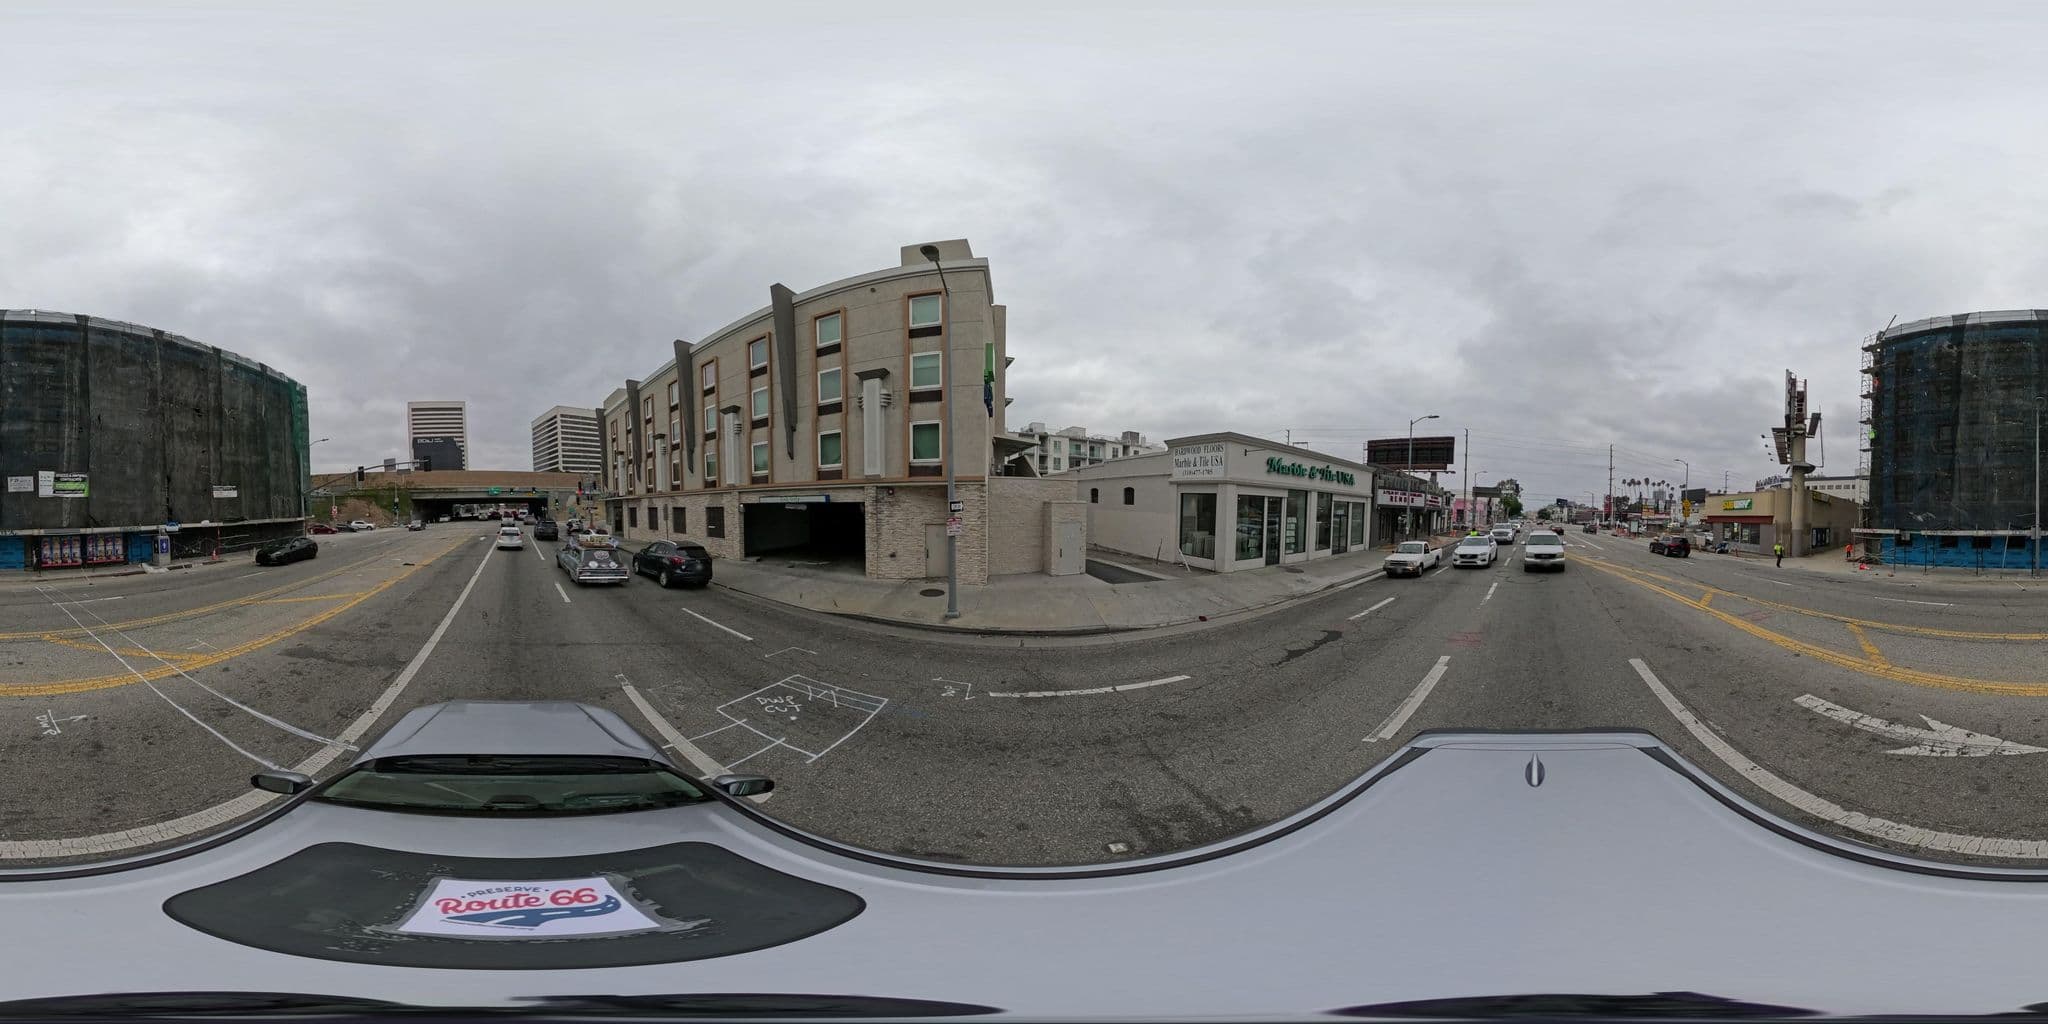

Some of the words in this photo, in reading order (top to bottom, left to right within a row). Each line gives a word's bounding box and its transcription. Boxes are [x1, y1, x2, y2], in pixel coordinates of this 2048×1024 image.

[1203, 444, 1224, 454] FLOORS
[1174, 457, 1191, 468] Marble
[1193, 457, 1198, 467] &
[1199, 456, 1209, 467] Tile
[1210, 455, 1223, 467] USA
[1266, 456, 1308, 477] Marble
[1308, 465, 1317, 480] &
[1316, 464, 1336, 481] Tile
[1336, 470, 1355, 486] USA
[765, 704, 802, 712] CUT
[466, 886, 541, 898] PRESERVE
[435, 892, 546, 915] Route
[549, 887, 599, 906] 66
